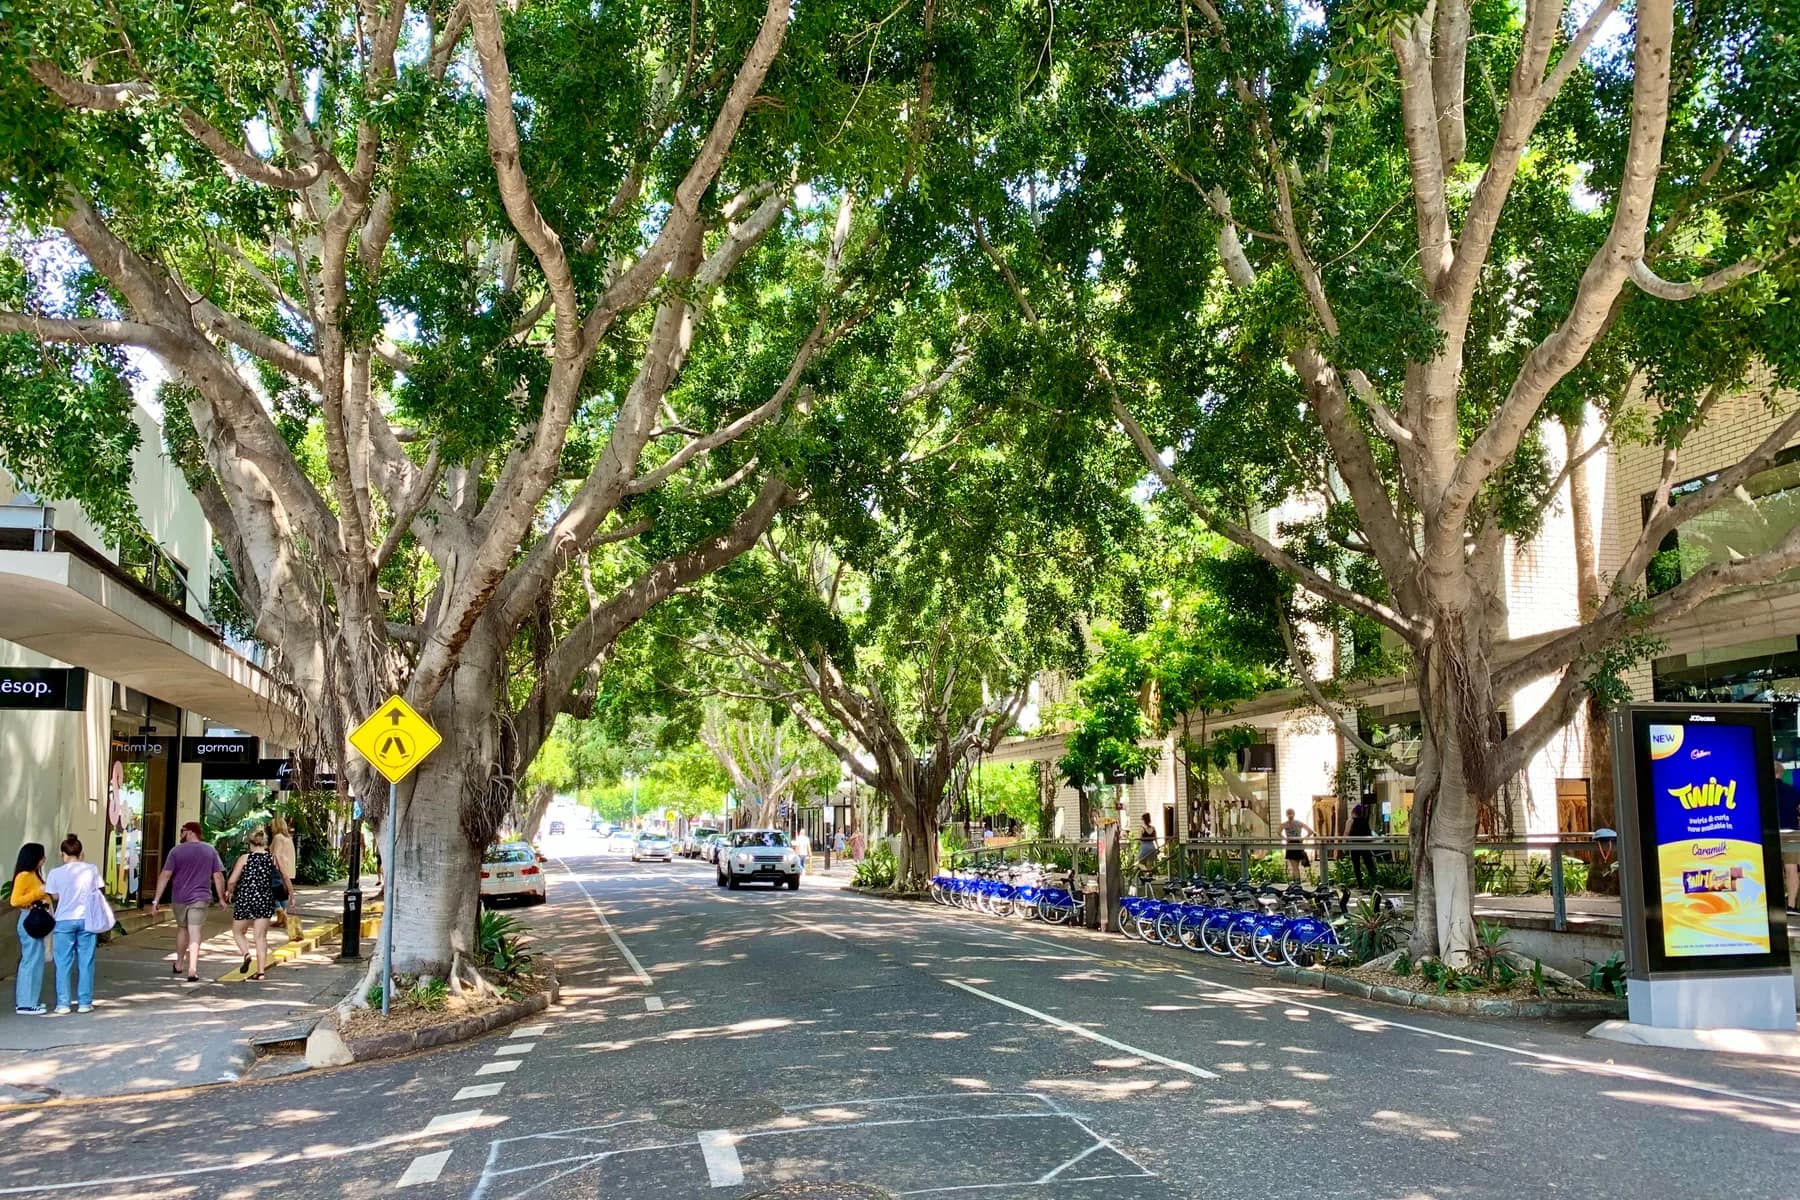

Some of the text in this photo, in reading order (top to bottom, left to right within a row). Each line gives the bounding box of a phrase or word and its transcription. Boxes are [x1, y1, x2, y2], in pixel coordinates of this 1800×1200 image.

[0, 679, 52, 698] ēsop.
[1653, 734, 1675, 743] NEW
[197, 744, 244, 754] gorman
[1667, 776, 1736, 810] Twirl
[1692, 841, 1728, 857] Caramilk
